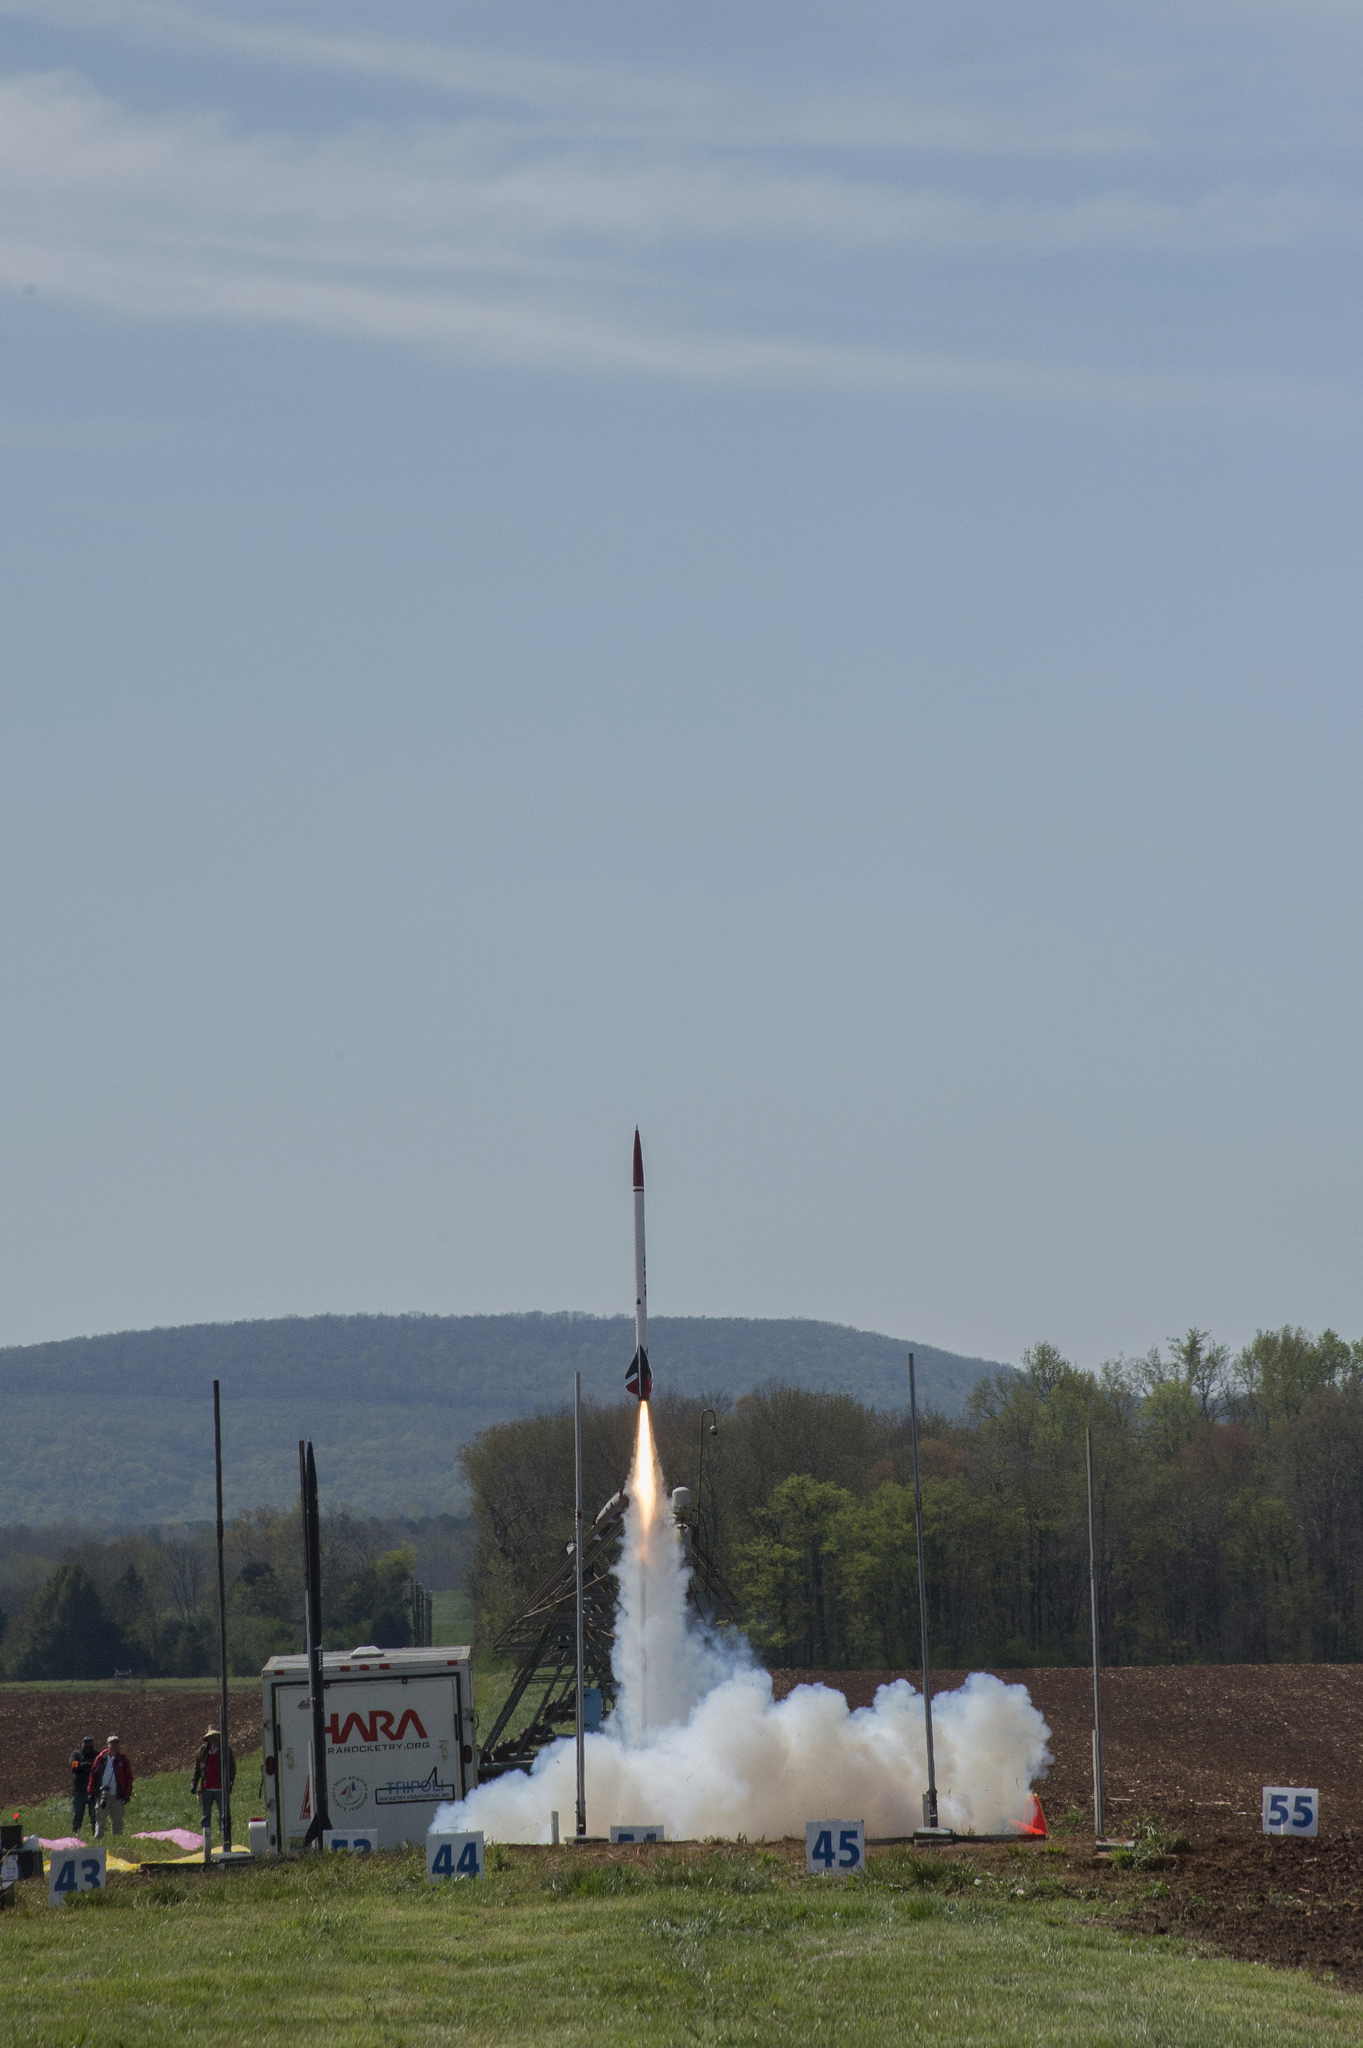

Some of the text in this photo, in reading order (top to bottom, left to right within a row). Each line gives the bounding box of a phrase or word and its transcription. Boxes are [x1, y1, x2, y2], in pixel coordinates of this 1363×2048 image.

[325, 1709, 428, 1744] HARA
[327, 1741, 431, 1755] RAROCKETRY.ORG
[385, 1779, 444, 1794] TRIPOLI
[1268, 1795, 1314, 1828] 55
[431, 1841, 480, 1879] 44
[812, 1830, 860, 1868] 45
[54, 1858, 101, 1892] 43
